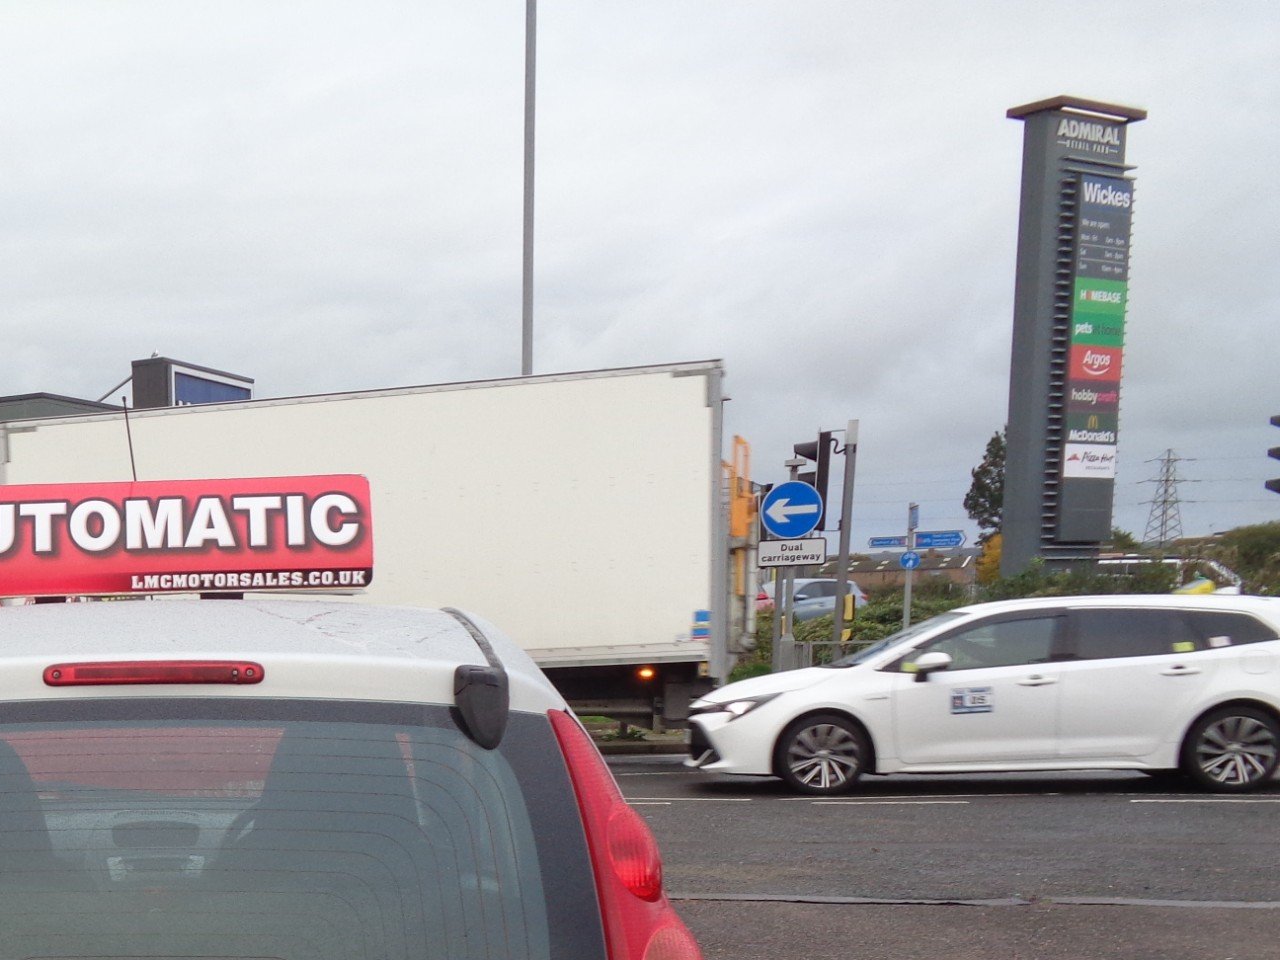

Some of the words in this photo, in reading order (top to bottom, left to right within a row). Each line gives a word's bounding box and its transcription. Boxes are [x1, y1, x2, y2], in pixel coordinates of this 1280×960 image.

[1057, 119, 1120, 145] ADMIRAL
[1083, 182, 1130, 208] Wickes
[1075, 322, 1093, 335] pets
[1082, 350, 1111, 368] Argos
[1069, 429, 1115, 442] McDonald's
[780, 542, 803, 552] Dual
[761, 553, 821, 562] carriageway
[131, 570, 366, 590] LMCMOTORSALES.CO.UK
